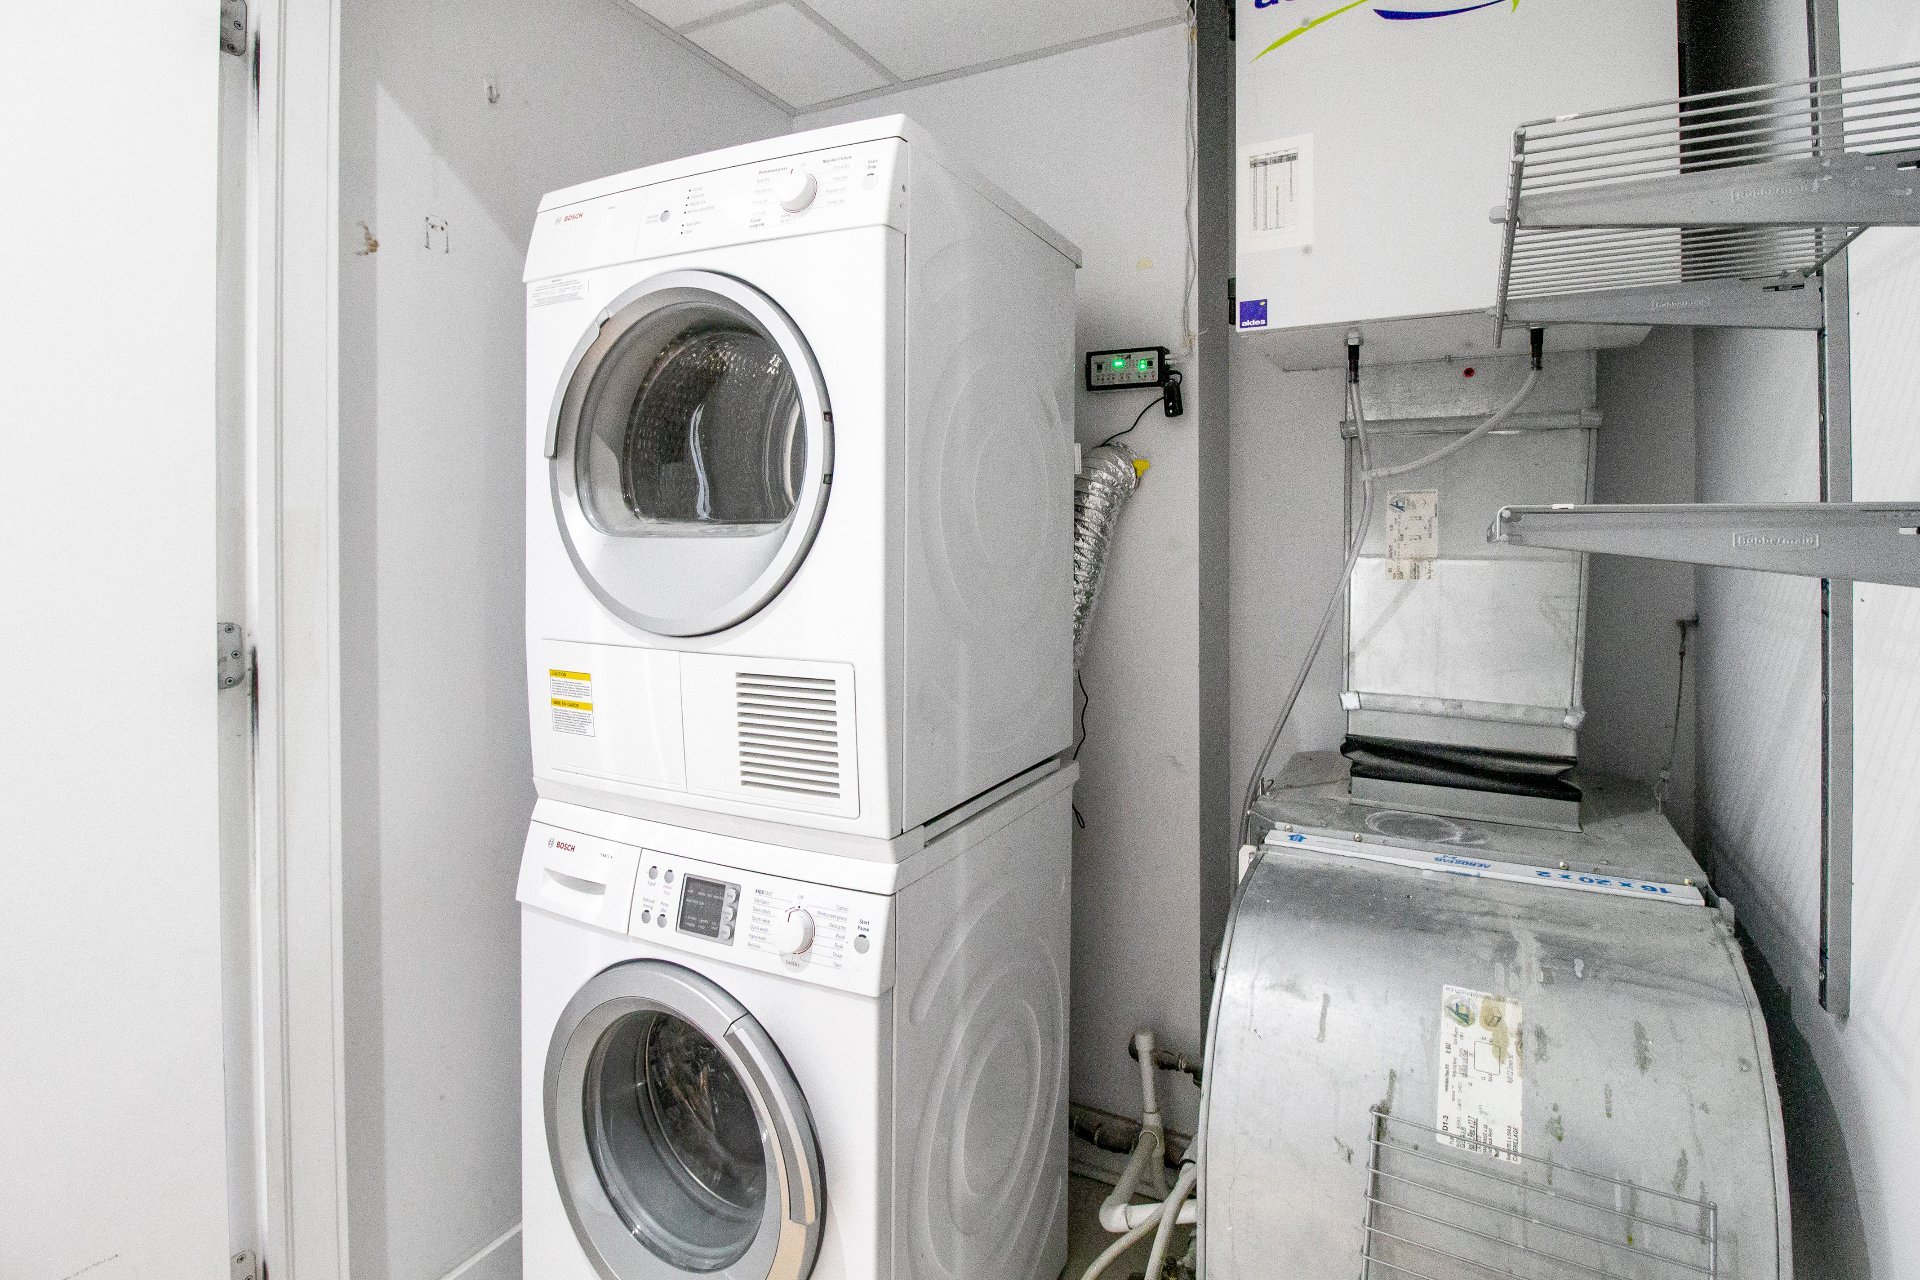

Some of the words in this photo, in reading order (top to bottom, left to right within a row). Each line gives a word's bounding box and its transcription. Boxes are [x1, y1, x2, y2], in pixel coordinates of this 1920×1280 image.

[563, 212, 584, 222] BOSCH
[1242, 319, 1266, 327] aldes
[556, 841, 575, 852] BOSCH
[1535, 870, 1552, 878] 2
[1578, 876, 1612, 886] 20
[1641, 885, 1671, 894] 16
[858, 918, 870, 926] Start
